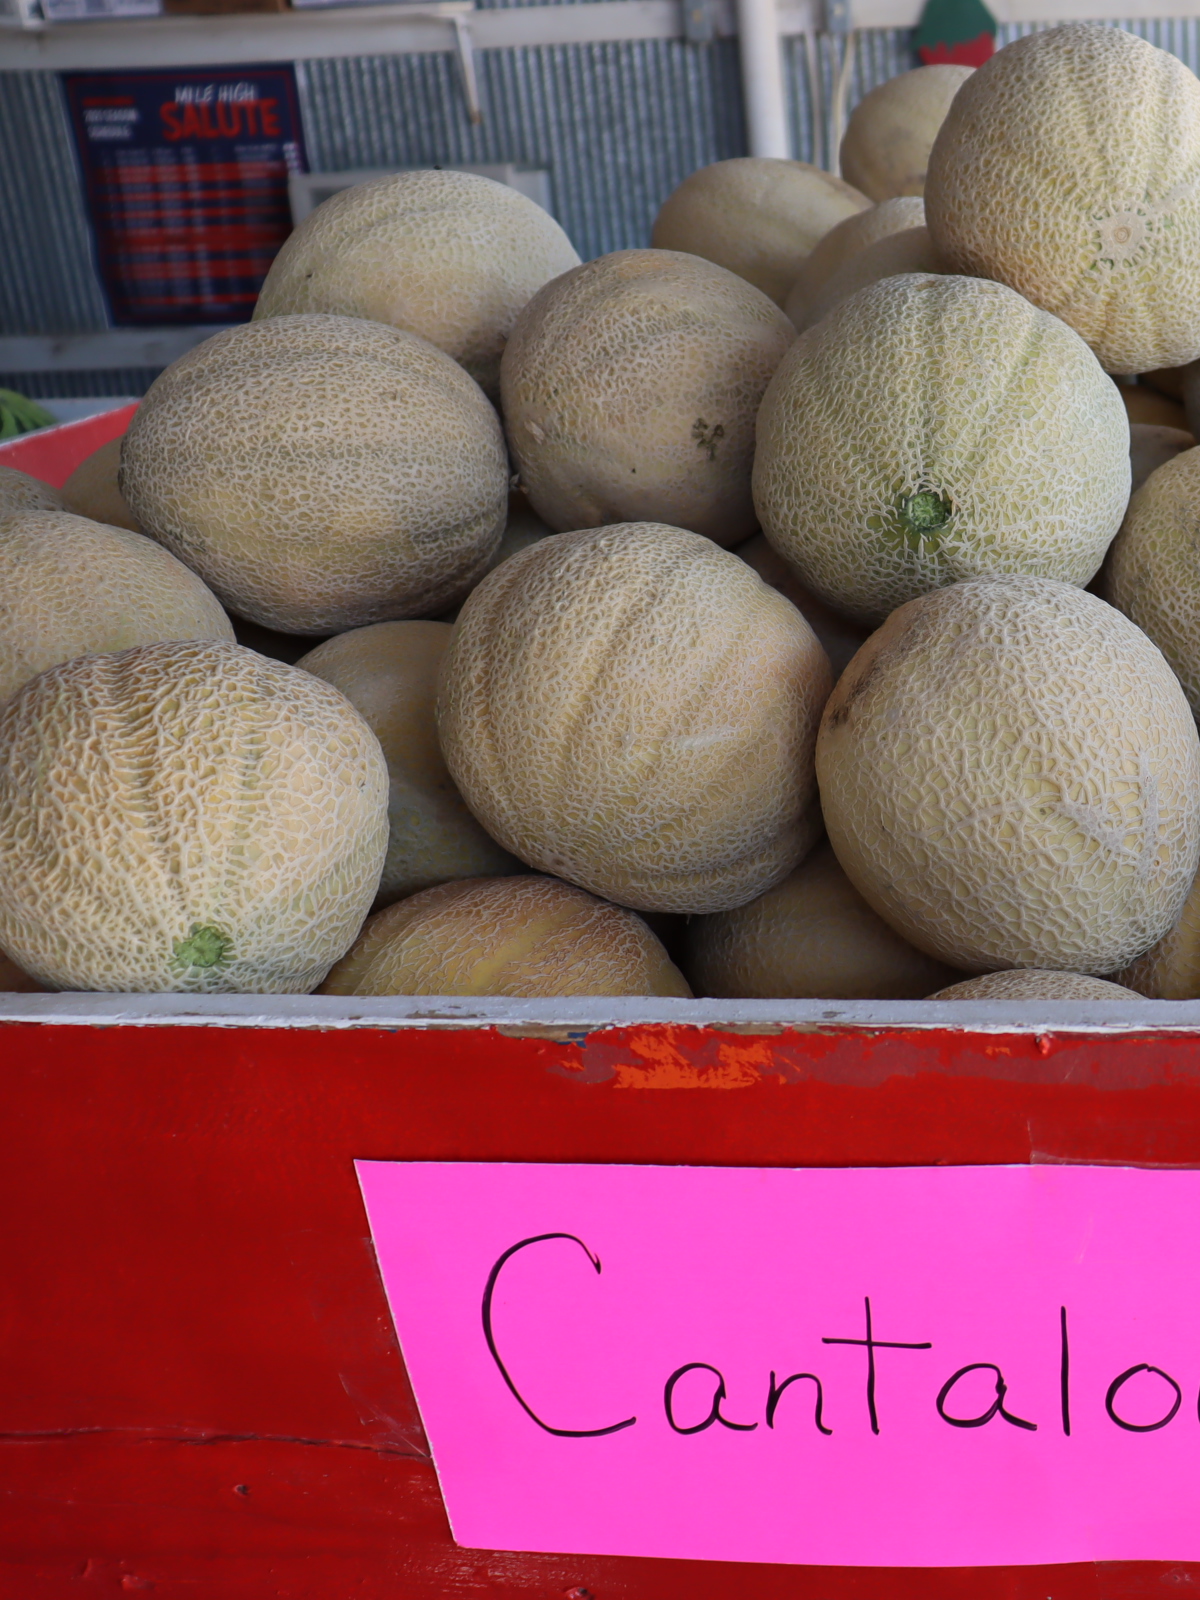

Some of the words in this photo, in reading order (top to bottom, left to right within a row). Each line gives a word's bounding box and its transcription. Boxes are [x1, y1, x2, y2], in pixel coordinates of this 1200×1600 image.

[176, 85, 214, 103] MILE
[220, 82, 256, 103] HIGH
[160, 99, 281, 140] SALUTE
